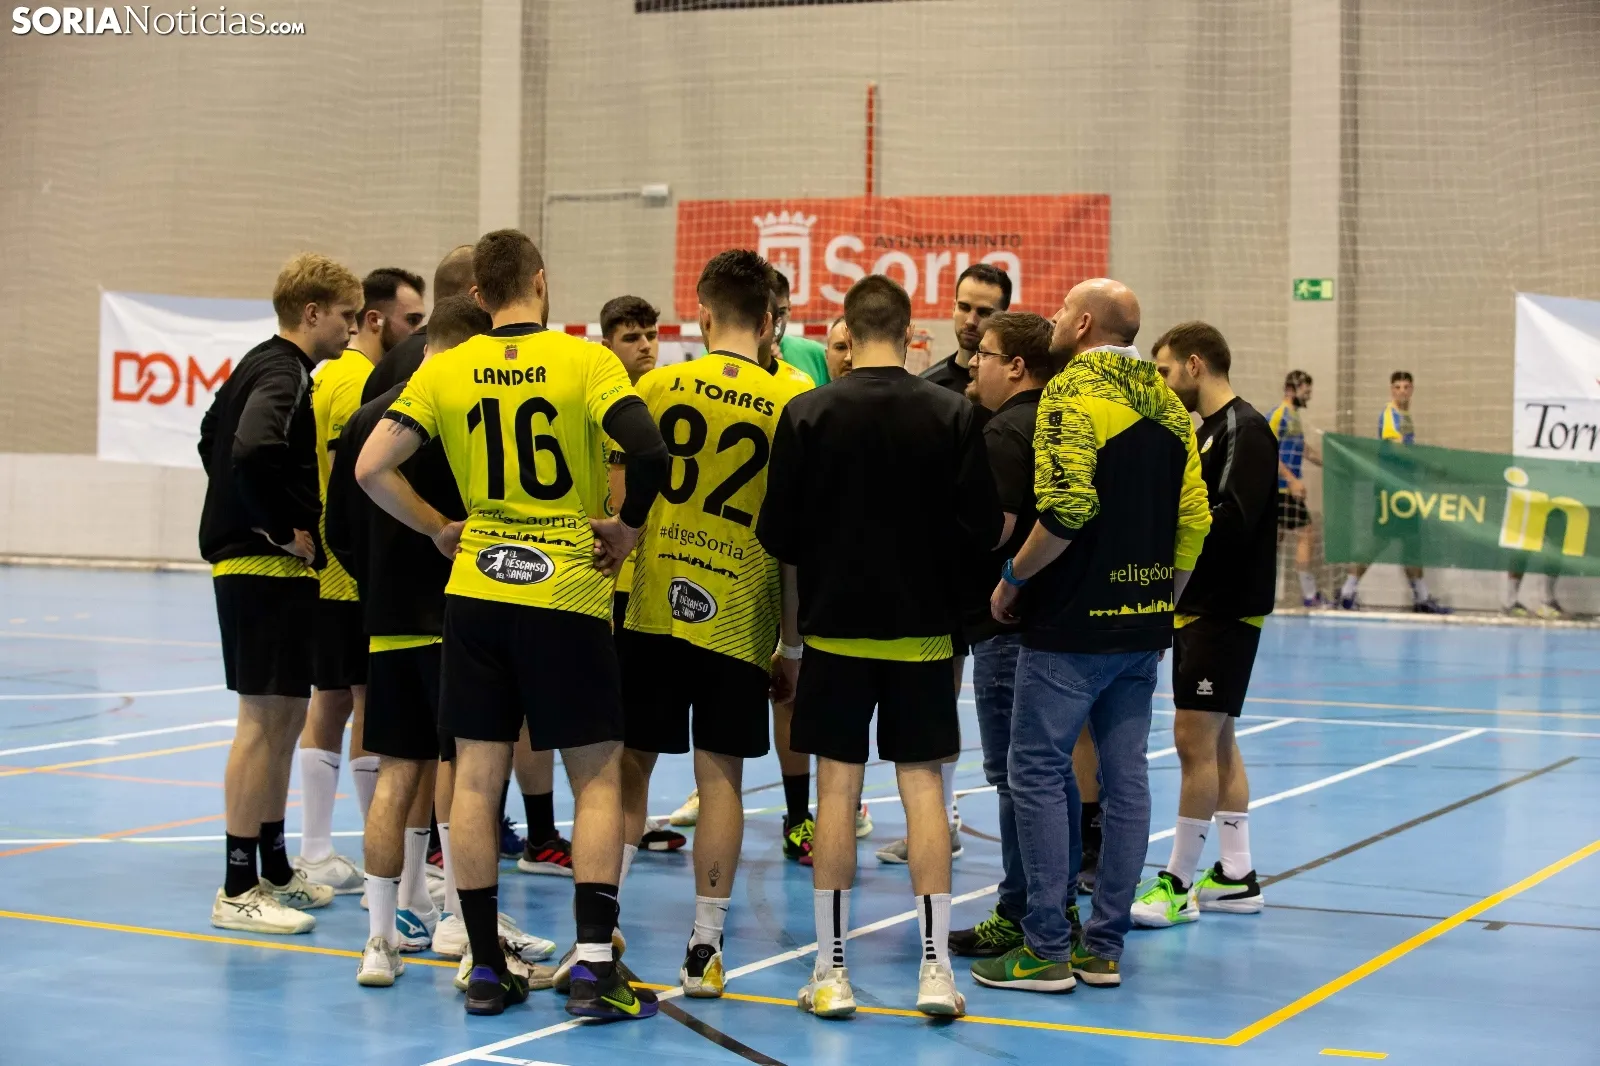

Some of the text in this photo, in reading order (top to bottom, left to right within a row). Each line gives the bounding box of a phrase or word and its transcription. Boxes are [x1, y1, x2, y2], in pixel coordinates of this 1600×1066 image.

[874, 232, 1022, 250] AYUNTAMIENTO
[473, 366, 547, 386] LANDER
[670, 377, 775, 417] J. TORRES
[467, 397, 573, 500] 16
[659, 403, 769, 528] 82
[1379, 466, 1590, 556] JOVEN in
[505, 558, 547, 573] DESCANSO
[1109, 562, 1174, 586] #eligeSor
